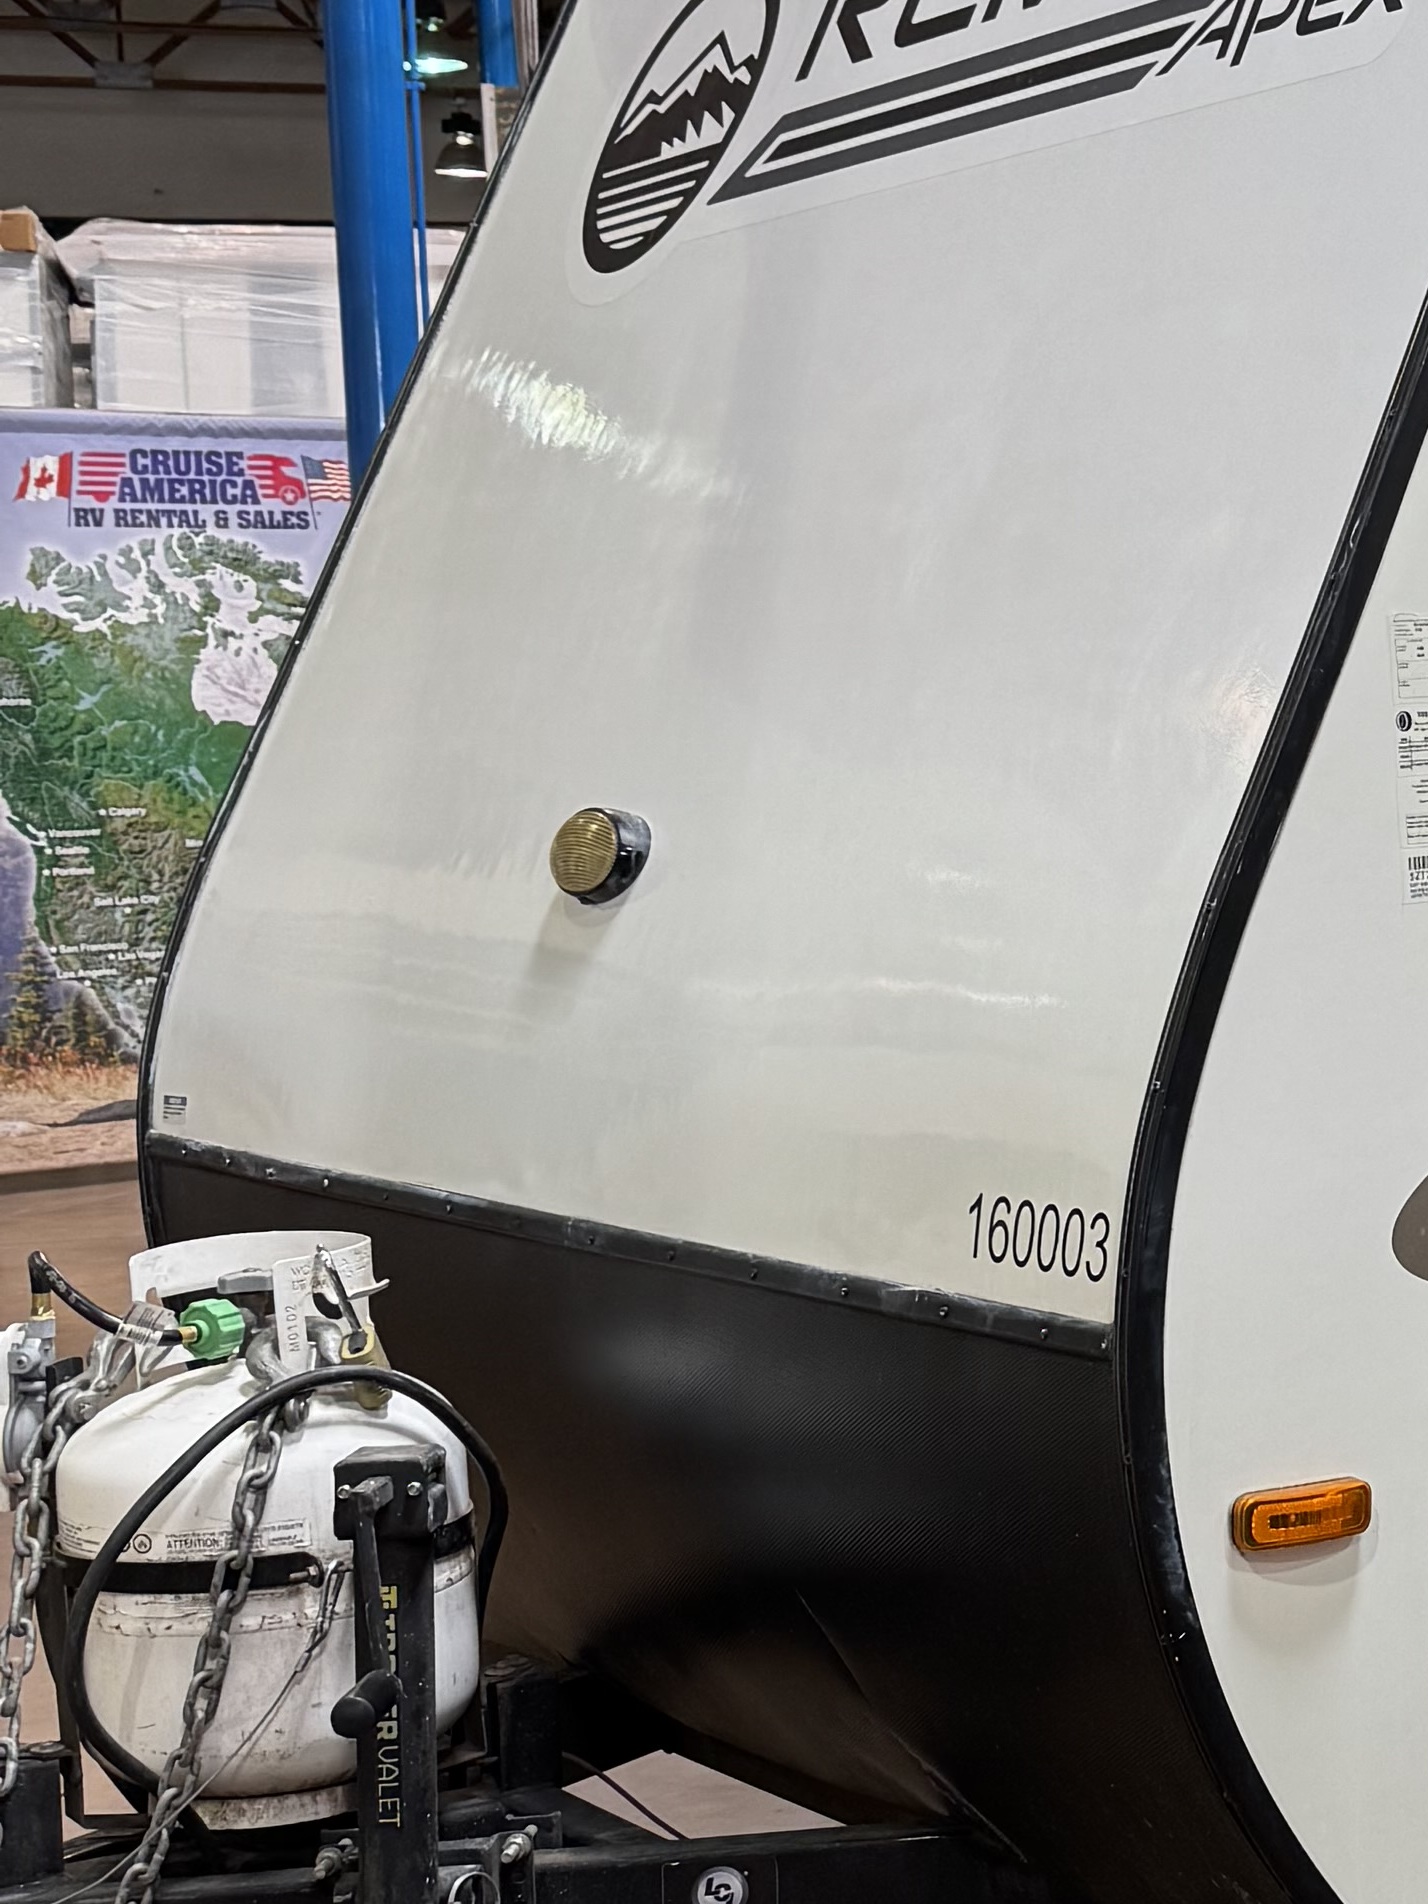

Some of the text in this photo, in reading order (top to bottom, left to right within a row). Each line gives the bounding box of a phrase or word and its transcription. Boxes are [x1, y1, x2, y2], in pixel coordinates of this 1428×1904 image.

[129, 448, 245, 477] CRUISE
[117, 477, 261, 505] AMERICA
[73, 507, 310, 530] RV RENTAL & SALES
[108, 807, 146, 817] Calgary
[52, 866, 96, 876] Portland
[968, 1192, 1111, 1283] 160003
[377, 1745, 401, 1828] VALET
